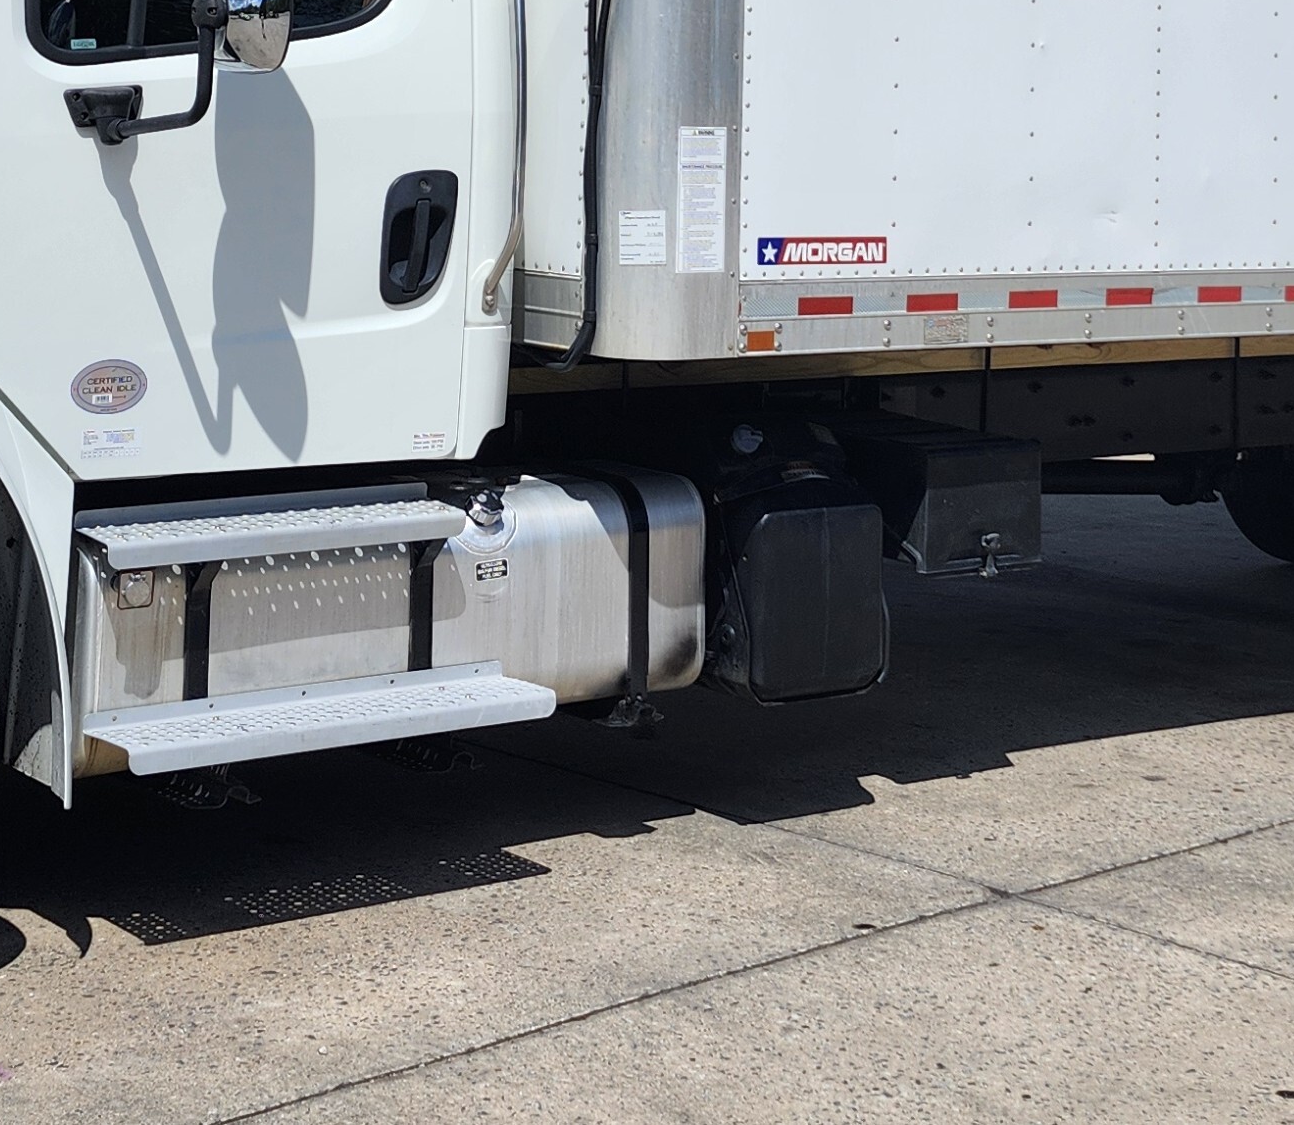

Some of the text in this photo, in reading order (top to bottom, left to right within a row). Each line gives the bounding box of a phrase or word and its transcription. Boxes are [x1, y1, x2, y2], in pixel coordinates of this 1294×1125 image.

[782, 242, 884, 262] MORGAN
[86, 375, 133, 385] CERTIFIED
[82, 384, 137, 395] CLEAN IDLE
